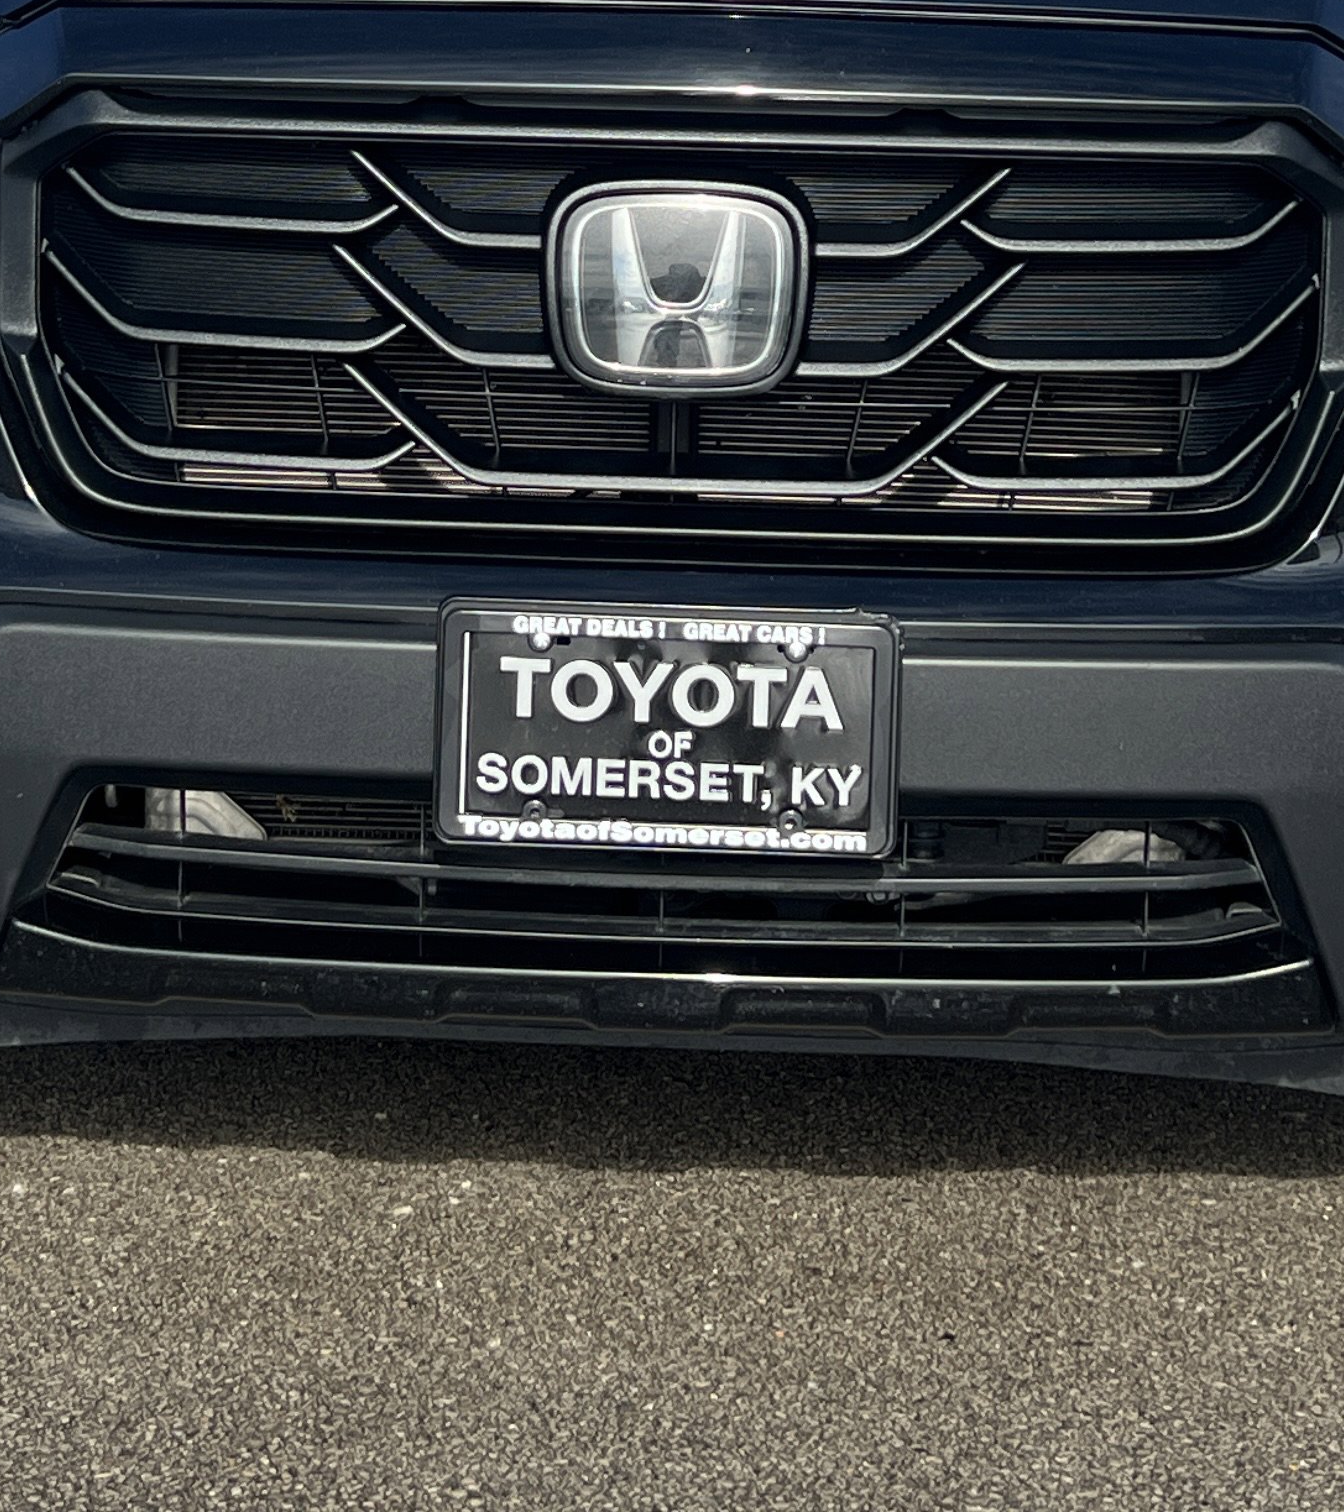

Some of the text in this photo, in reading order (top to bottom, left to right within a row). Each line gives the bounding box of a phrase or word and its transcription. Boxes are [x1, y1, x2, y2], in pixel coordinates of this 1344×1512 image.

[512, 615, 582, 636] GREAT
[586, 618, 654, 638] DEALS
[682, 622, 753, 643] GREAT
[756, 625, 814, 646] CARS
[499, 655, 844, 732] TOYOTA
[647, 730, 693, 759] OF
[475, 752, 862, 811] SOMERSET, KY
[459, 814, 868, 852] ToyotaofSomerset.com
